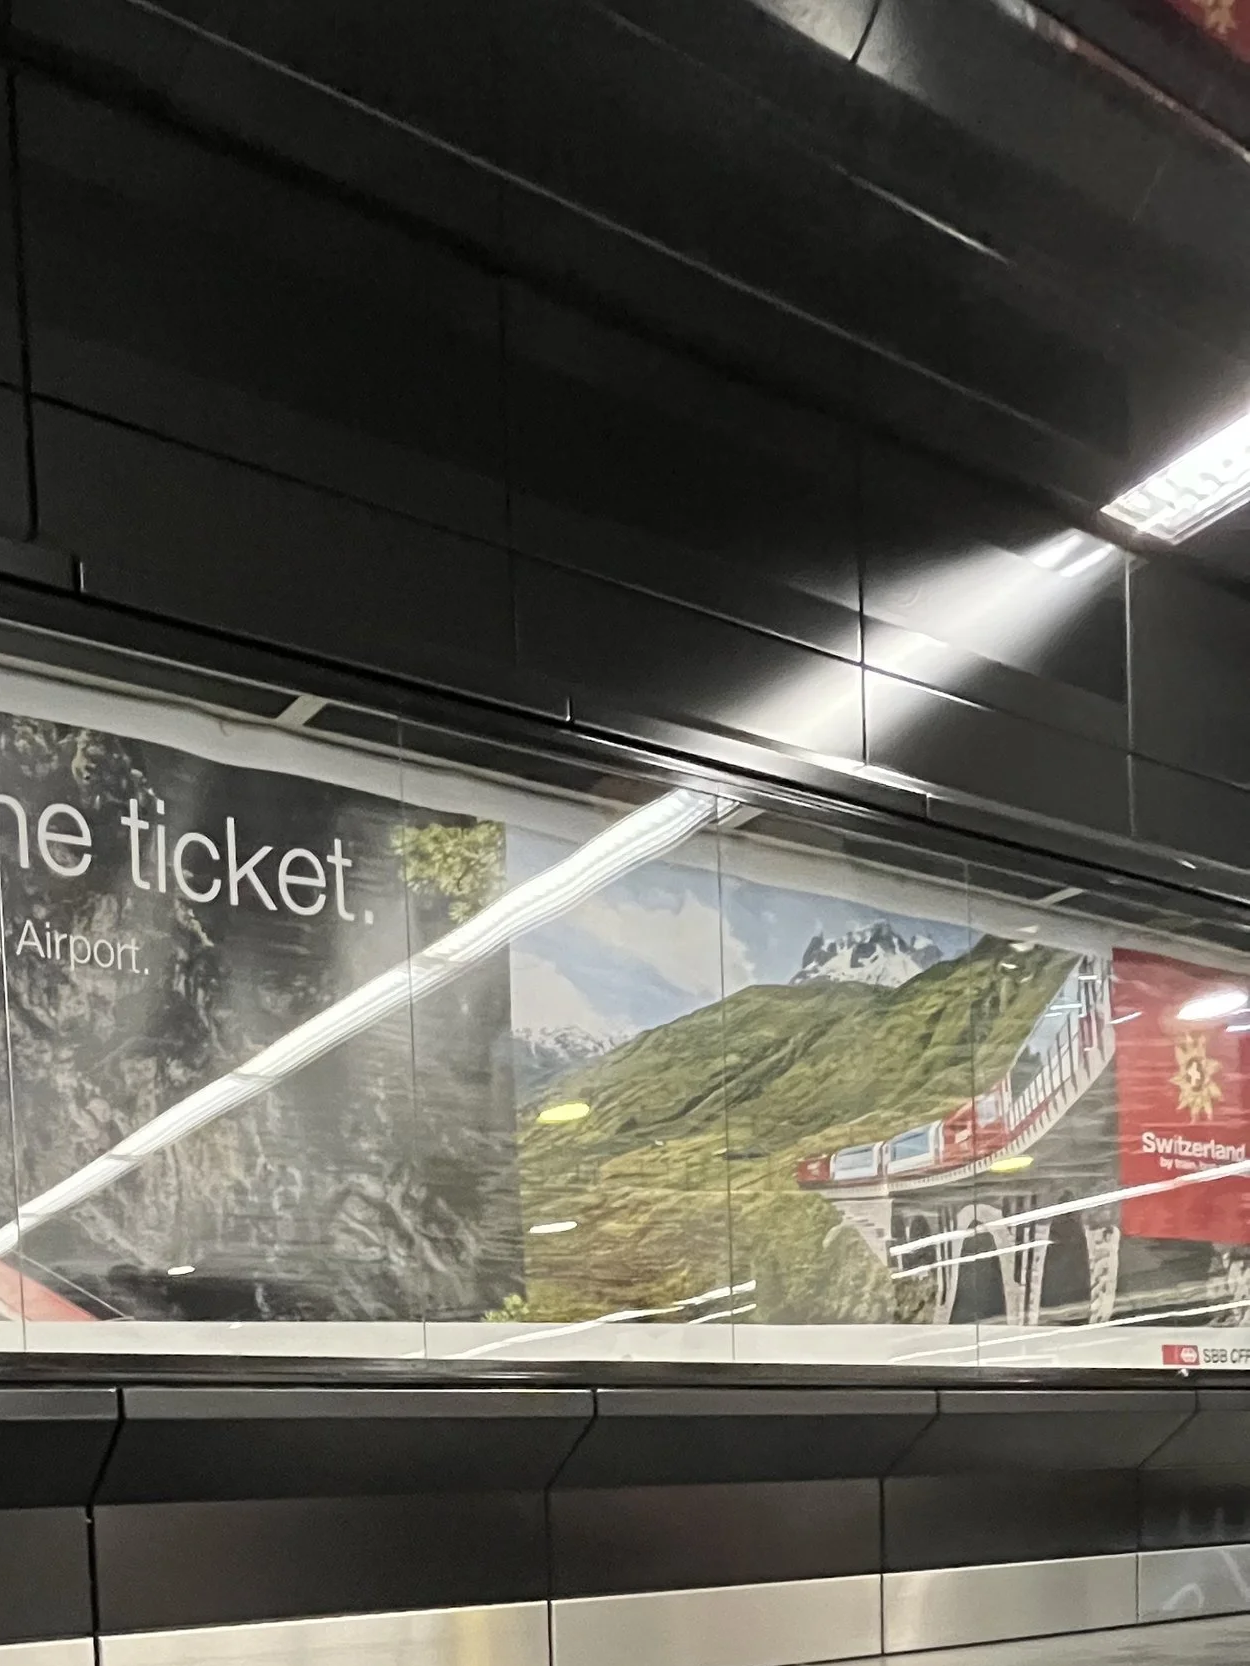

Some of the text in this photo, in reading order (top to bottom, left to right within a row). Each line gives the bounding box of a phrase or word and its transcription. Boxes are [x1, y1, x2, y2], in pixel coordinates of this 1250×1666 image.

[120, 799, 374, 925] ticket.
[16, 918, 150, 976] Airport.
[1141, 1131, 1247, 1162] Switzerland
[1203, 1348, 1228, 1363] SBB
